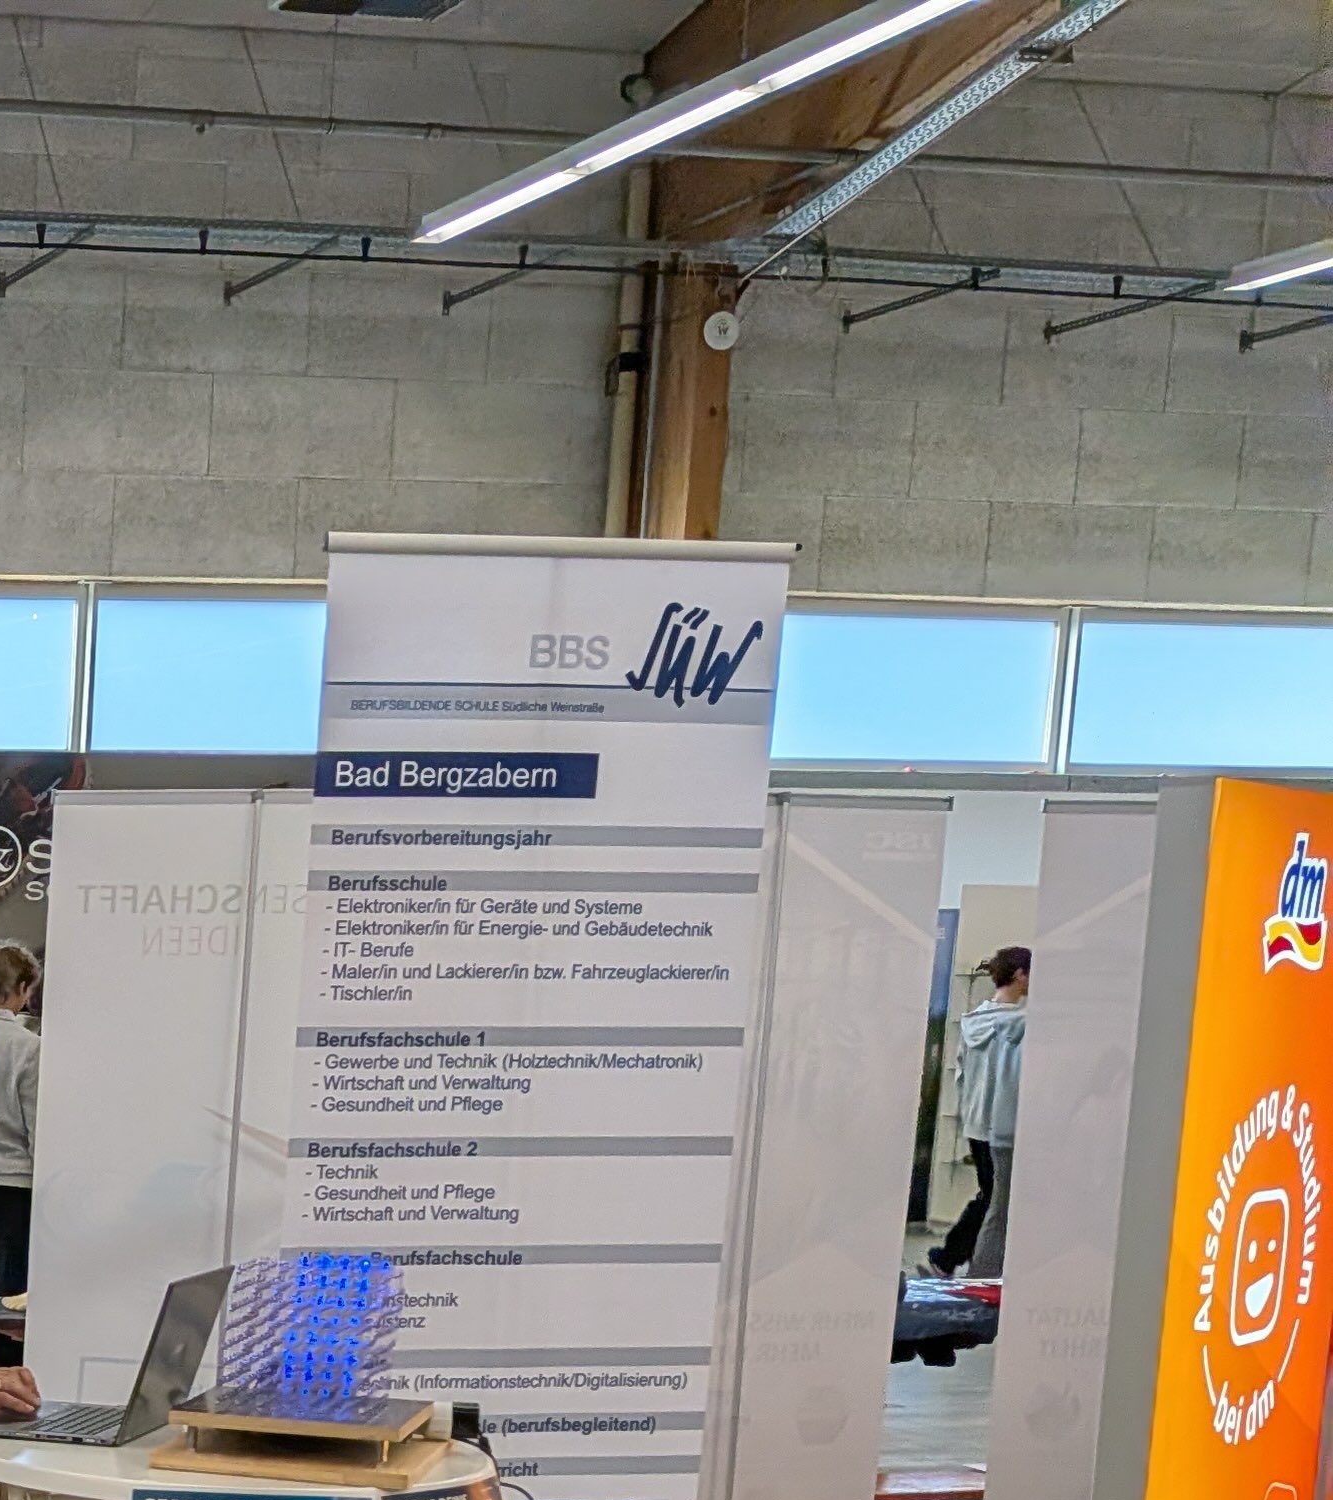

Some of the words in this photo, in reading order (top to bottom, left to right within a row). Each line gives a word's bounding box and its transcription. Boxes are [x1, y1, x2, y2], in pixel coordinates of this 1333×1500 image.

[528, 634, 611, 671] BBS
[350, 699, 452, 713] BERUFSBILDENDE
[455, 700, 499, 713] SCHULE
[551, 701, 605, 715] Weinstraße
[334, 760, 388, 788] Bad
[399, 762, 558, 793] Bergzabern
[331, 828, 552, 850] Berufsvorbereitungsjahr
[328, 875, 447, 892] Berufsschule
[1280, 838, 1326, 919] dm
[337, 898, 450, 913] Elektroniker/in
[456, 898, 476, 913] für
[481, 898, 537, 914] Geräte
[543, 899, 570, 914] und
[575, 899, 642, 918] Systeme
[336, 920, 448, 935] Elektroniker/in
[454, 920, 474, 935] für
[479, 920, 548, 939] Energie-
[553, 921, 580, 936] und
[585, 921, 712, 936] Gebäudetechnik
[361, 942, 413, 957] Berufe
[332, 964, 397, 979] Maler/in
[403, 964, 431, 979] und
[437, 964, 528, 979] Lackierer/in
[534, 964, 564, 979] bzw.
[572, 964, 729, 983] Fahrzeuglackierer/in
[331, 985, 412, 1000] Tischler/in
[316, 1030, 472, 1048] Berufsfachschule
[476, 1031, 487, 1047] 1
[325, 1054, 399, 1069] Gewerbe
[404, 1054, 432, 1069] und
[437, 1054, 497, 1068] Technik
[503, 1053, 702, 1072] (Holztechnik/Mechatronik)
[324, 1076, 404, 1090] Wirtschaft
[409, 1075, 437, 1090] und
[442, 1075, 531, 1094] Verwaltung
[322, 1097, 414, 1112] Gesundheit
[419, 1096, 446, 1111] und
[451, 1096, 503, 1115] Pflege
[307, 1141, 462, 1158] Berufsfachschule
[467, 1141, 478, 1157] 2
[317, 1165, 378, 1179] Technik
[315, 1185, 406, 1200] Gesundheit
[411, 1185, 439, 1200] und
[444, 1184, 495, 1203] Pflege
[313, 1207, 393, 1221] Wirtschaft
[399, 1206, 426, 1221] und
[431, 1206, 519, 1224] Verwaltung
[1193, 1088, 1280, 1332] Ausbildung
[1280, 1083, 1296, 1133] &
[1293, 1102, 1321, 1305] Studium
[414, 1371, 688, 1392] (Informationstechnik/Digitalisierung)
[1213, 1379, 1244, 1446] bei
[1245, 1378, 1276, 1441] dm
[501, 1416, 657, 1436] (berufsbegleitend)
